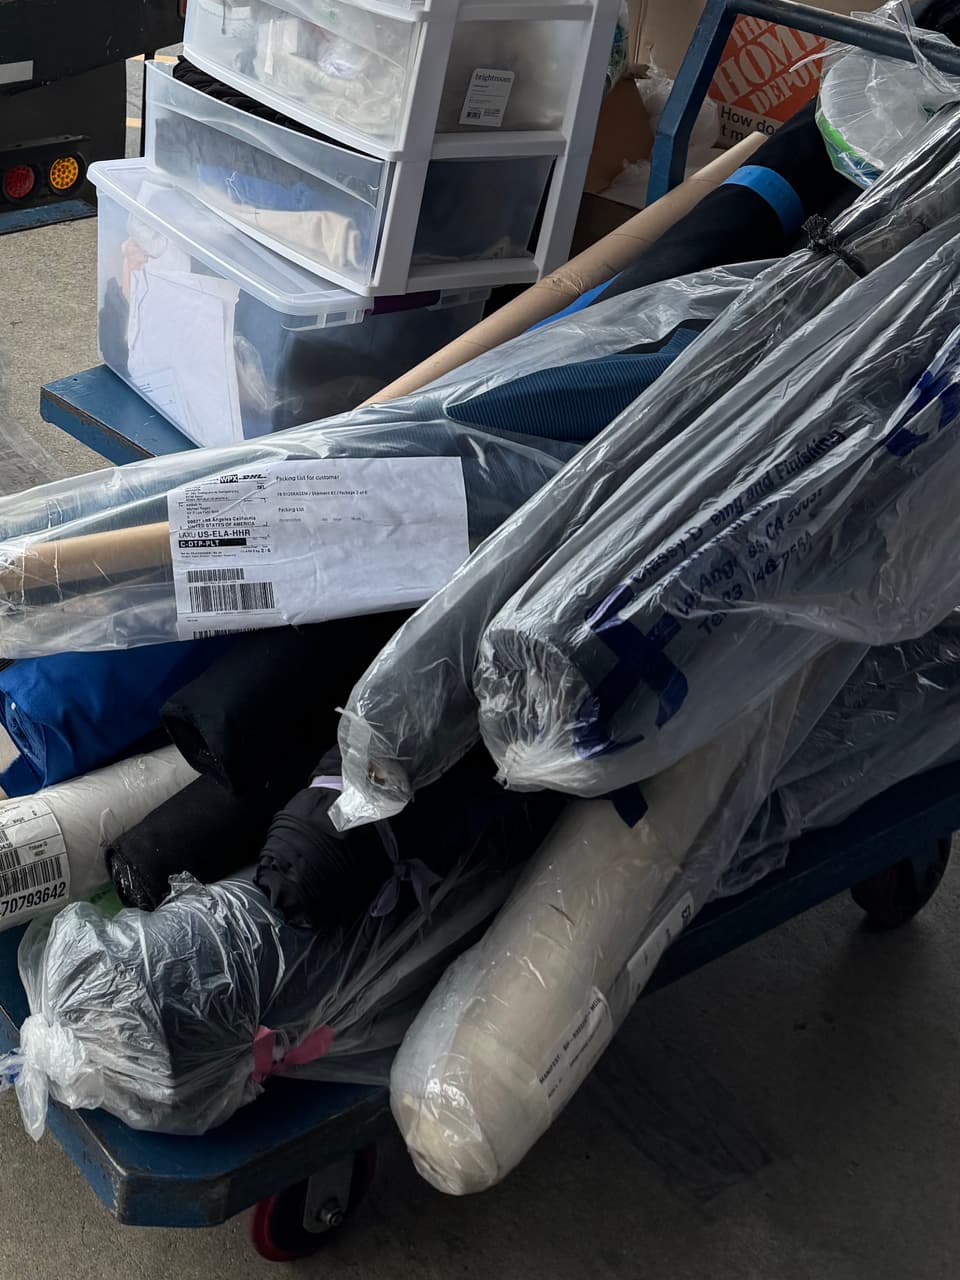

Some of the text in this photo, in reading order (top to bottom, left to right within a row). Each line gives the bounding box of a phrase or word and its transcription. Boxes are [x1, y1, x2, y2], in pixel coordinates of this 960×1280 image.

[720, 105, 752, 128] How
[775, 428, 847, 482] Finishing
[220, 474, 238, 483] WPX
[197, 529, 251, 539] US-ELA-HHR
